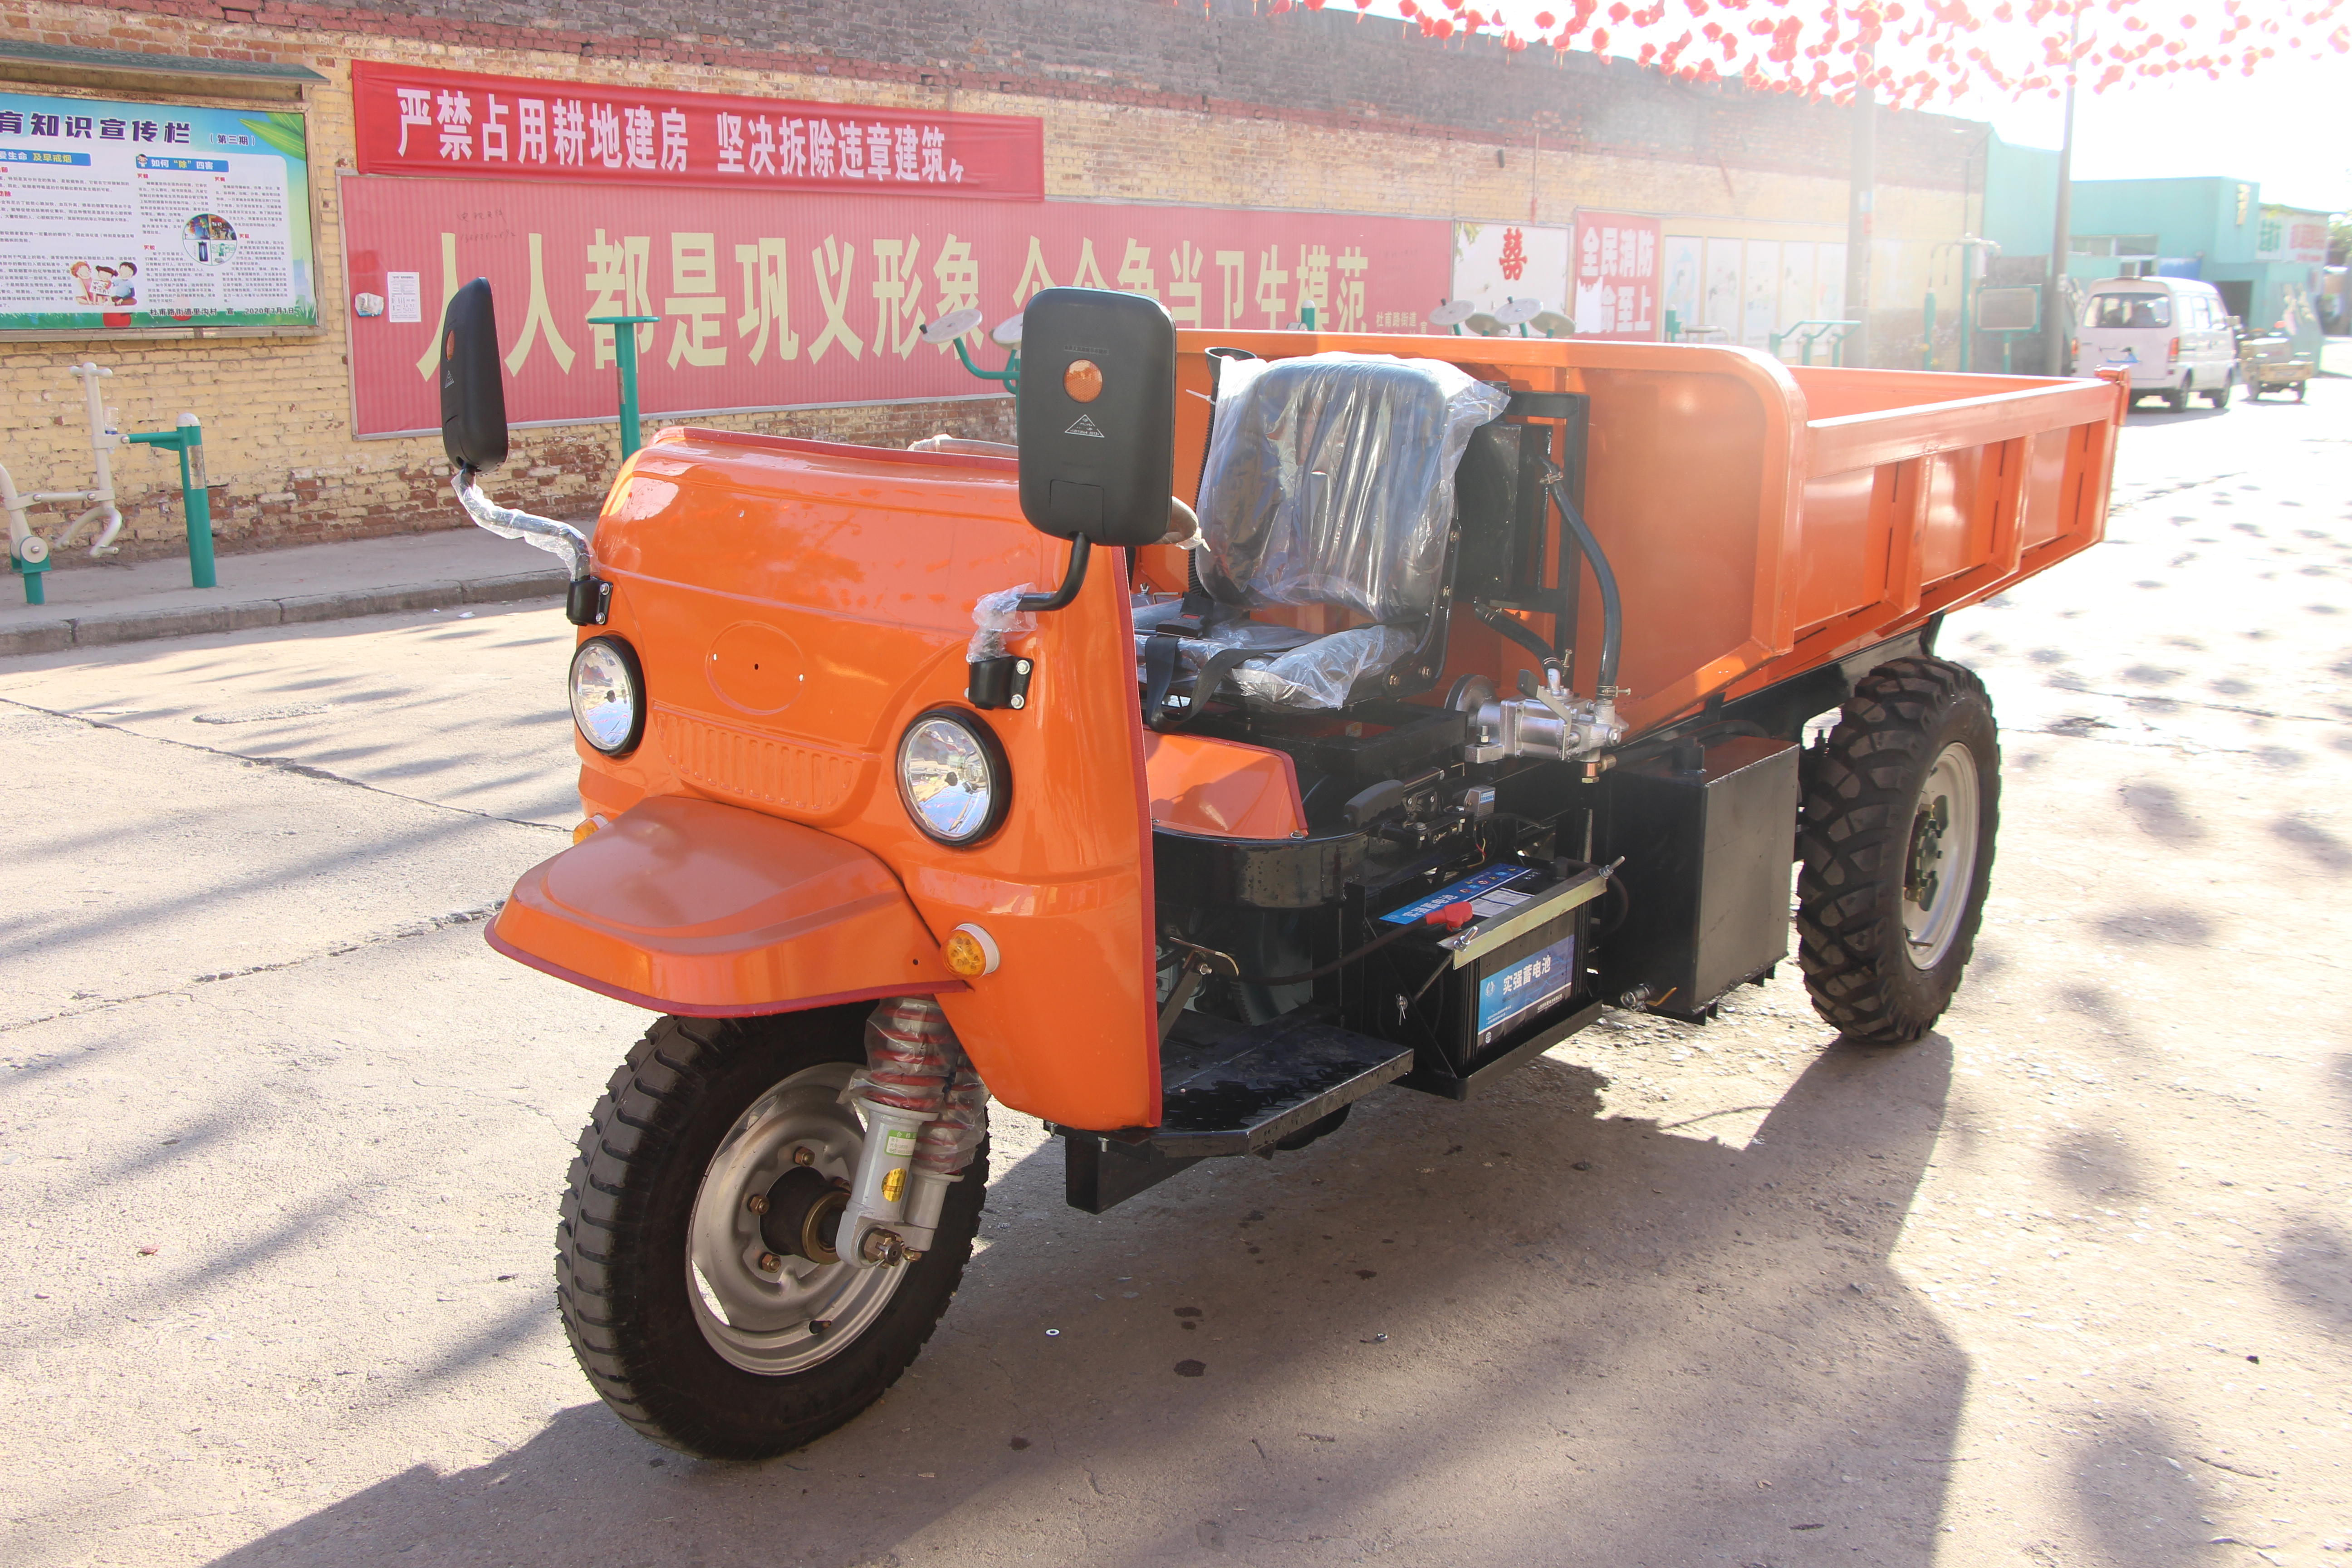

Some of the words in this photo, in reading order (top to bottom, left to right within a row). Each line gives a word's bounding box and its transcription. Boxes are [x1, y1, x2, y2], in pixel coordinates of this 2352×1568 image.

[0, 110, 191, 144] 育知识宣传栏
[397, 88, 689, 172] 严禁占用耕地建房
[33, 152, 72, 163] 及早戒烟
[151, 158, 169, 168] 如何
[196, 161, 213, 171] 四害
[1581, 227, 1655, 277] 全民消防
[150, 308, 217, 316] 杜甫路街道里沟村
[1376, 311, 1416, 327] 杜甫路街道
[1588, 284, 1652, 333] 命至上
[1401, 894, 1459, 917] 实强蓄电池
[1503, 954, 1551, 995] 实强蓄电池
